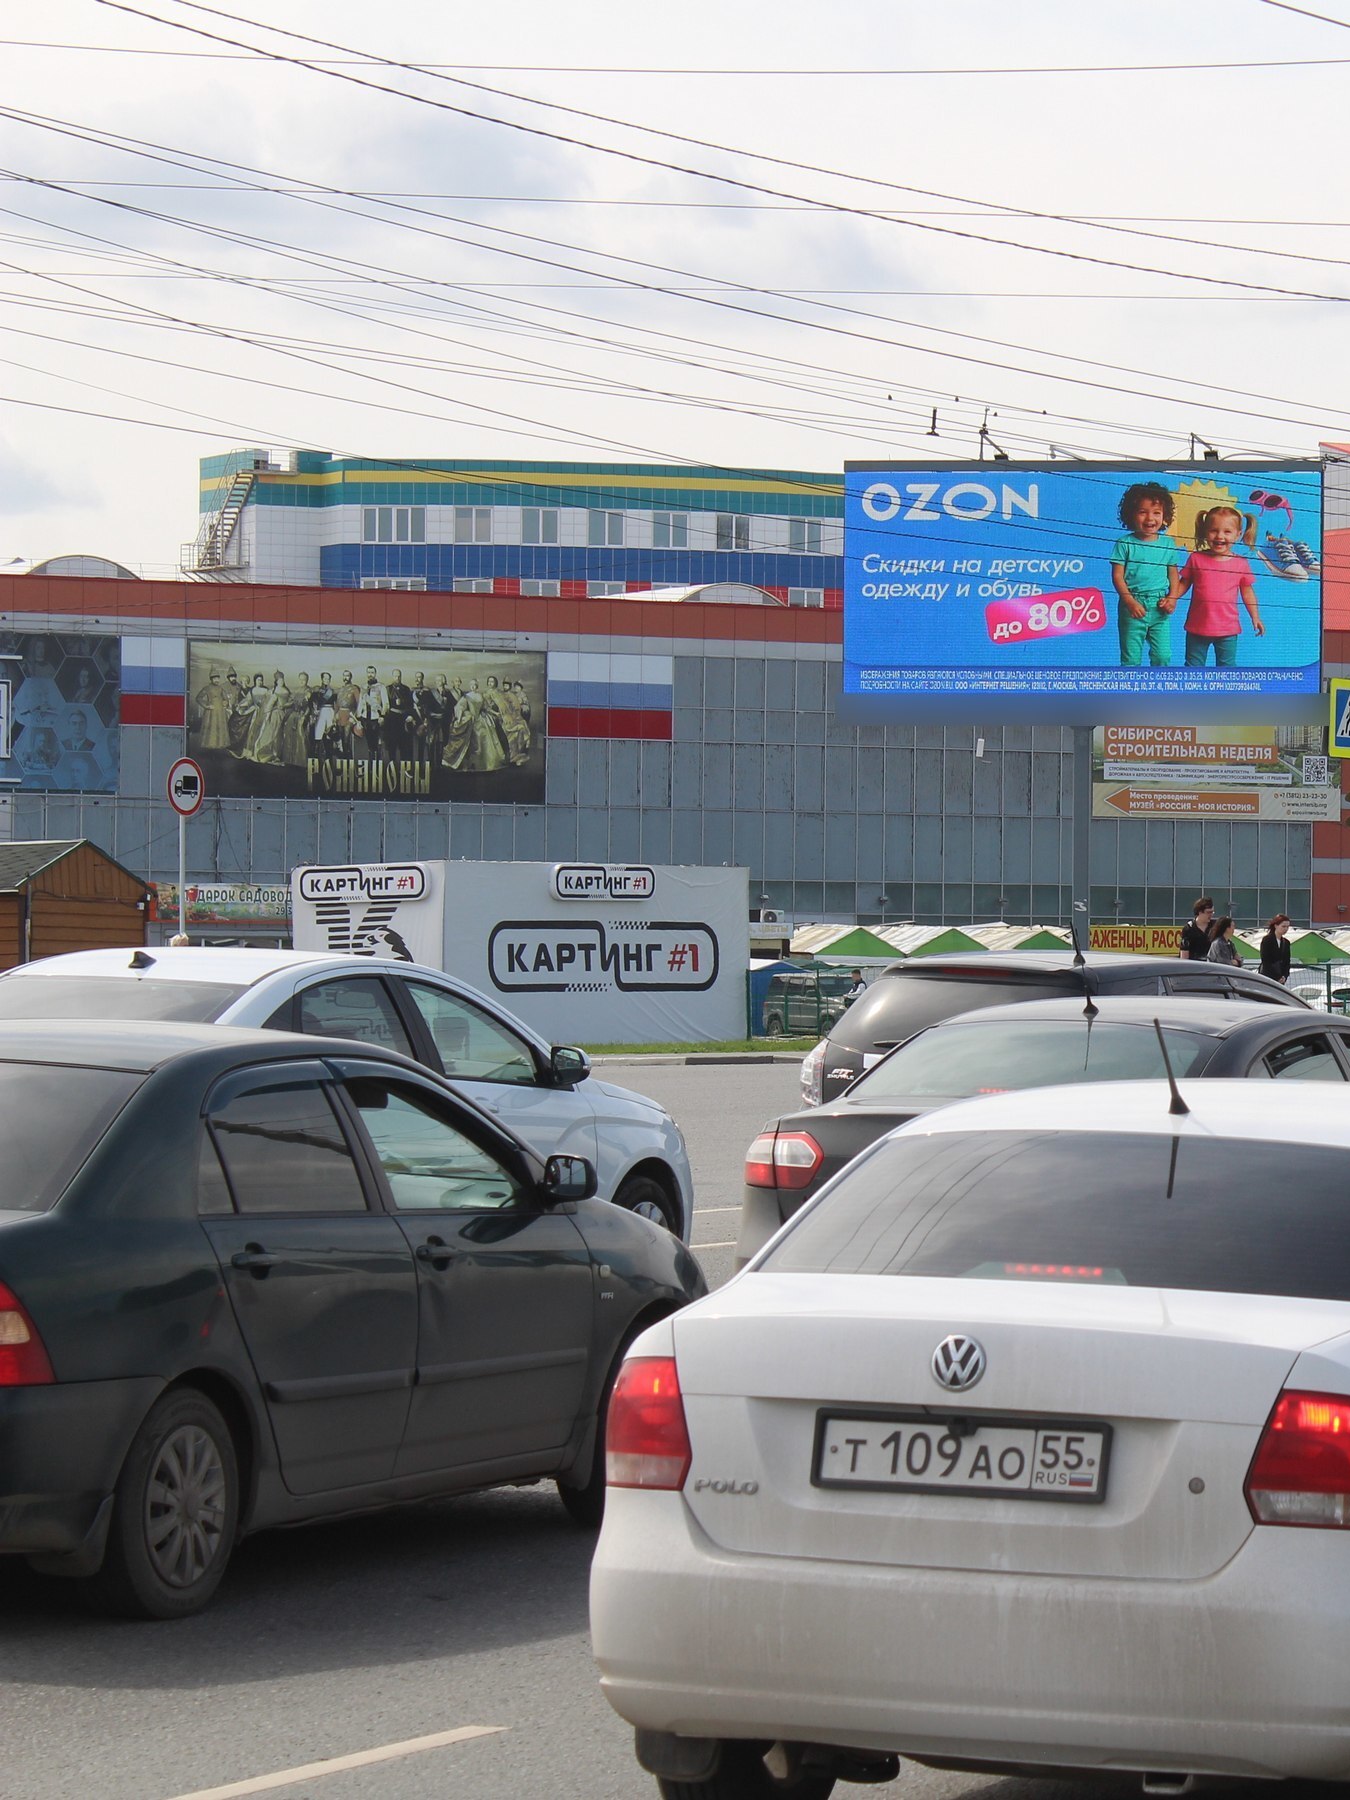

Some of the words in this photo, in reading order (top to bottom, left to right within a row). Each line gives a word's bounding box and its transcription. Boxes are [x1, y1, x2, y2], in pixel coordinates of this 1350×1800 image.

[861, 482, 1039, 522] OZON
[862, 553, 945, 576] Скидки
[952, 559, 981, 573] на
[988, 559, 1084, 578] детскую
[862, 583, 950, 601] одежду
[956, 583, 970, 597] и
[978, 577, 1043, 600] обувь
[993, 620, 1023, 640] до
[1027, 595, 1101, 631] 80%
[1107, 727, 1192, 743] СИБИРСКАЯ
[1107, 743, 1216, 758] СТРОИТЕЛЬНАЯ
[1220, 746, 1272, 761] НЕДЕЛЯ
[307, 757, 430, 794] РОМАНОВЫ
[1129, 792, 1153, 800] Место
[1153, 793, 1199, 802] проведения:
[1129, 800, 1154, 809] МУЗЕЙ
[1198, 803, 1215, 811] МОЯ
[310, 877, 395, 893] КАРТИНГ
[397, 875, 415, 890] #1
[564, 875, 631, 890] КАРТИНГ
[632, 875, 648, 890] #1
[507, 943, 663, 973] КАРТИНГ
[667, 943, 700, 973] #1
[1039, 1434, 1086, 1470] 55
[694, 1478, 760, 1496] POLO
[1035, 1471, 1068, 1485] RUS
